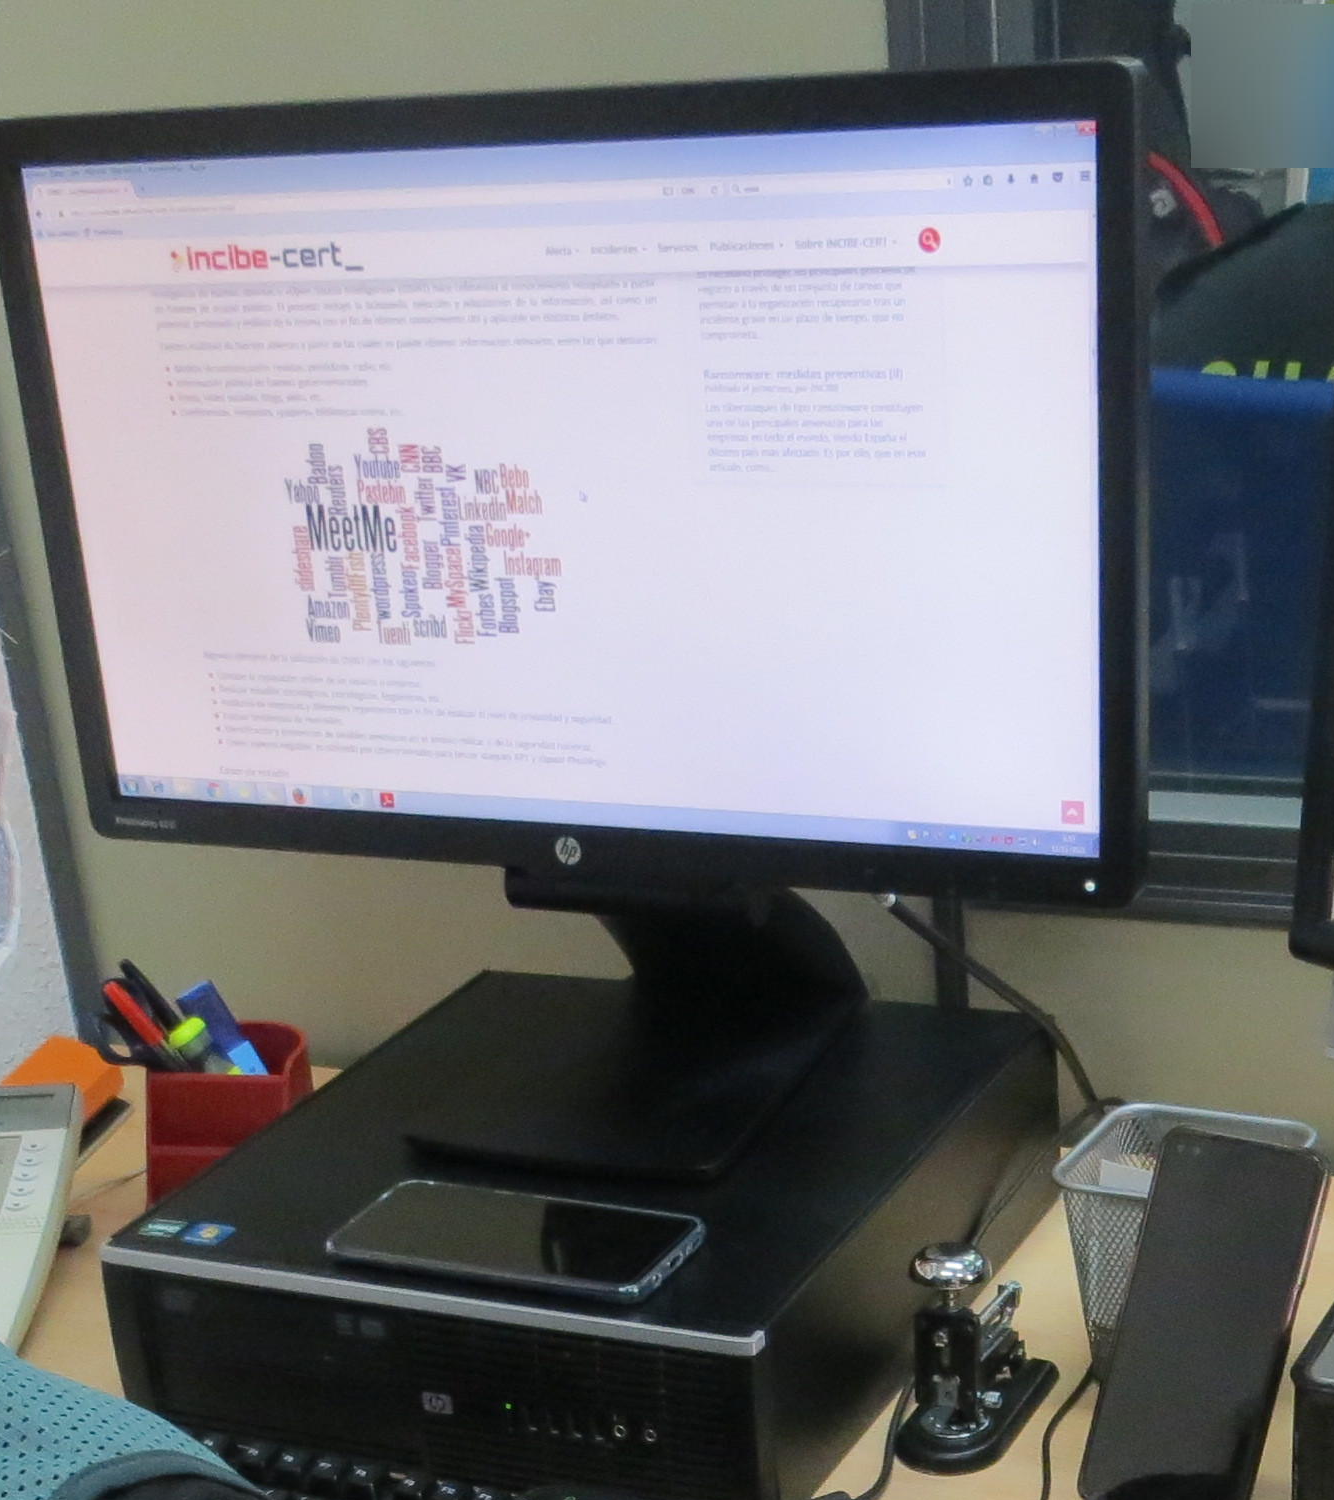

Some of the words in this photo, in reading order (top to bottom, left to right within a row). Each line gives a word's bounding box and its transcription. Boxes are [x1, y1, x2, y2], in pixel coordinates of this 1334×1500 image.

[590, 244, 638, 255] Incidentes
[658, 242, 699, 254] Servicios
[710, 240, 774, 252] Publicaciones
[795, 239, 823, 250] Sobre
[777, 369, 822, 379] medidas
[824, 369, 886, 382] preventivas
[871, 403, 923, 414] constituyen
[367, 427, 390, 454] CBS
[354, 453, 401, 479] Youtube
[399, 444, 421, 473] CNN
[421, 446, 443, 473] BBC
[445, 463, 466, 482] VK
[499, 462, 529, 489] Bebo
[284, 478, 320, 503] Yahoo
[326, 465, 348, 516] Reuters
[357, 479, 407, 505] Pastebin
[414, 477, 438, 522] Twitter
[506, 488, 543, 515] Match
[306, 504, 397, 552] MeetMe
[435, 487, 461, 547] Pinterest
[396, 507, 420, 570] Facebook
[422, 540, 444, 590] Blogger
[464, 525, 490, 592] Wikipedia
[503, 550, 562, 580] Instagram
[325, 556, 347, 598] Tumblr
[445, 546, 470, 608] MySpace
[307, 594, 351, 620] Amazon
[534, 580, 557, 612] Ebay
[453, 609, 475, 645] Flickr
[475, 592, 497, 637] Forbes
[305, 618, 341, 644] Vimeo
[376, 619, 411, 646] Tuenti
